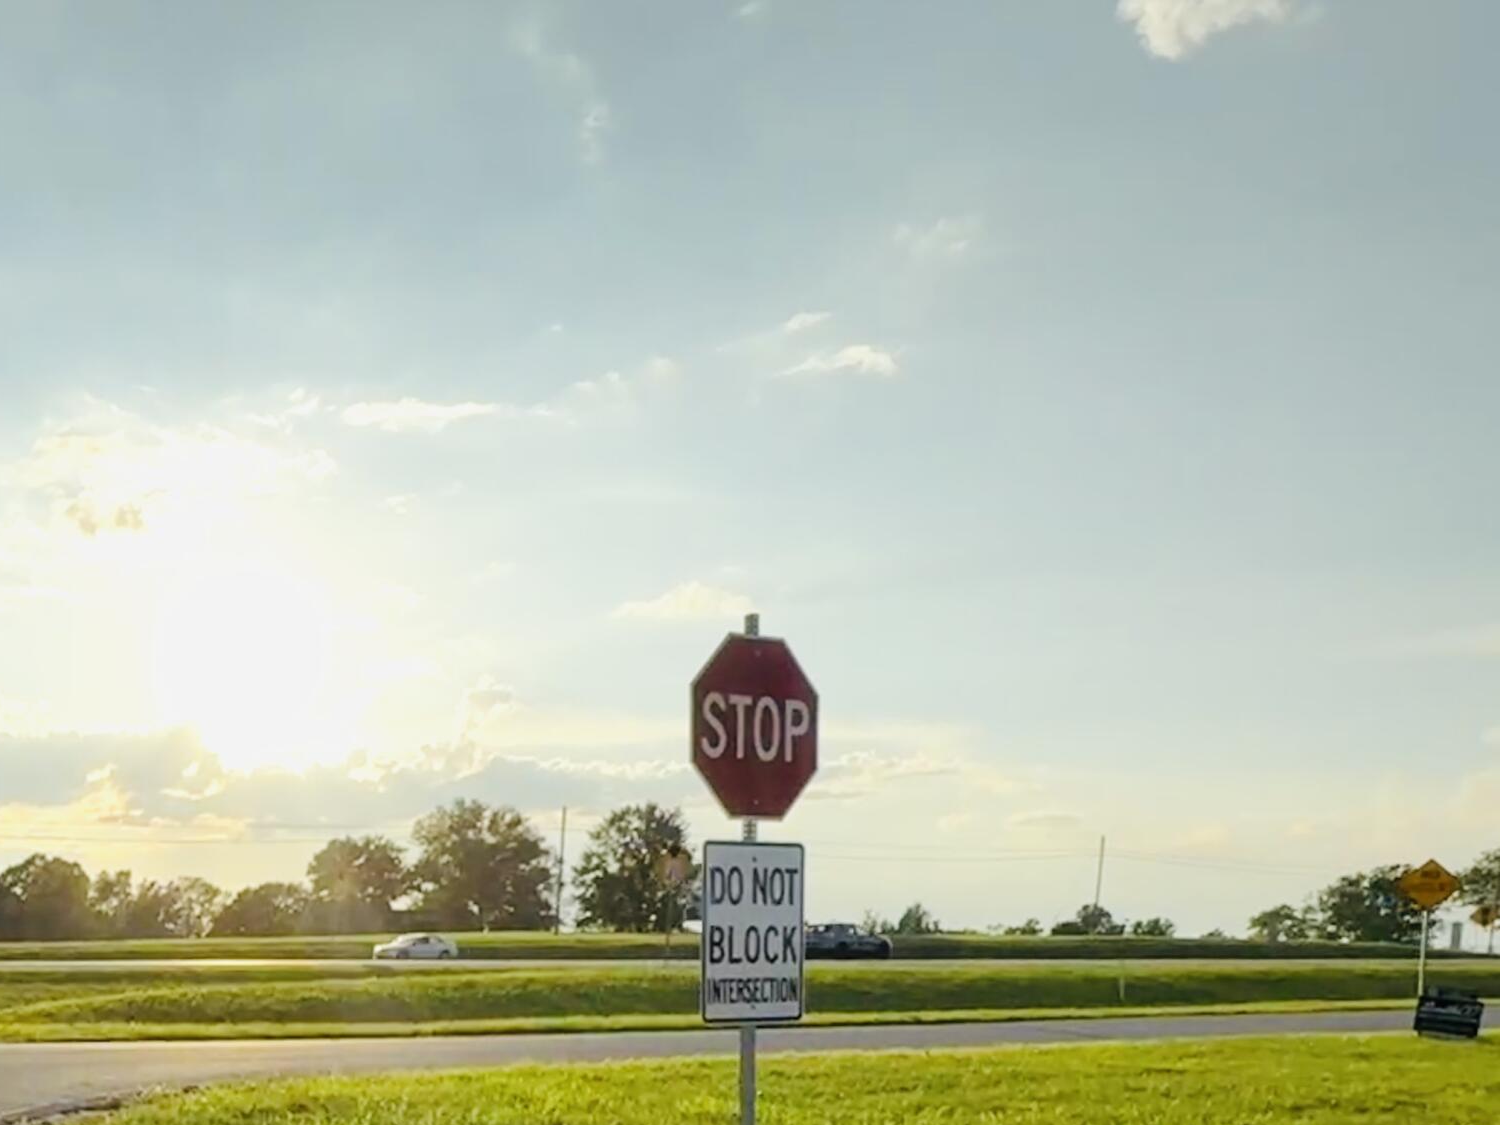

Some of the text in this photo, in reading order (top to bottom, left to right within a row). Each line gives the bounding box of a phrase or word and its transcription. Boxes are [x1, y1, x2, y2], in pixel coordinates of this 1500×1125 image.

[702, 691, 810, 762] STOP
[709, 866, 798, 906] DO NOT
[709, 925, 797, 965] BLOCK
[707, 977, 798, 1004] INTERSECTION
